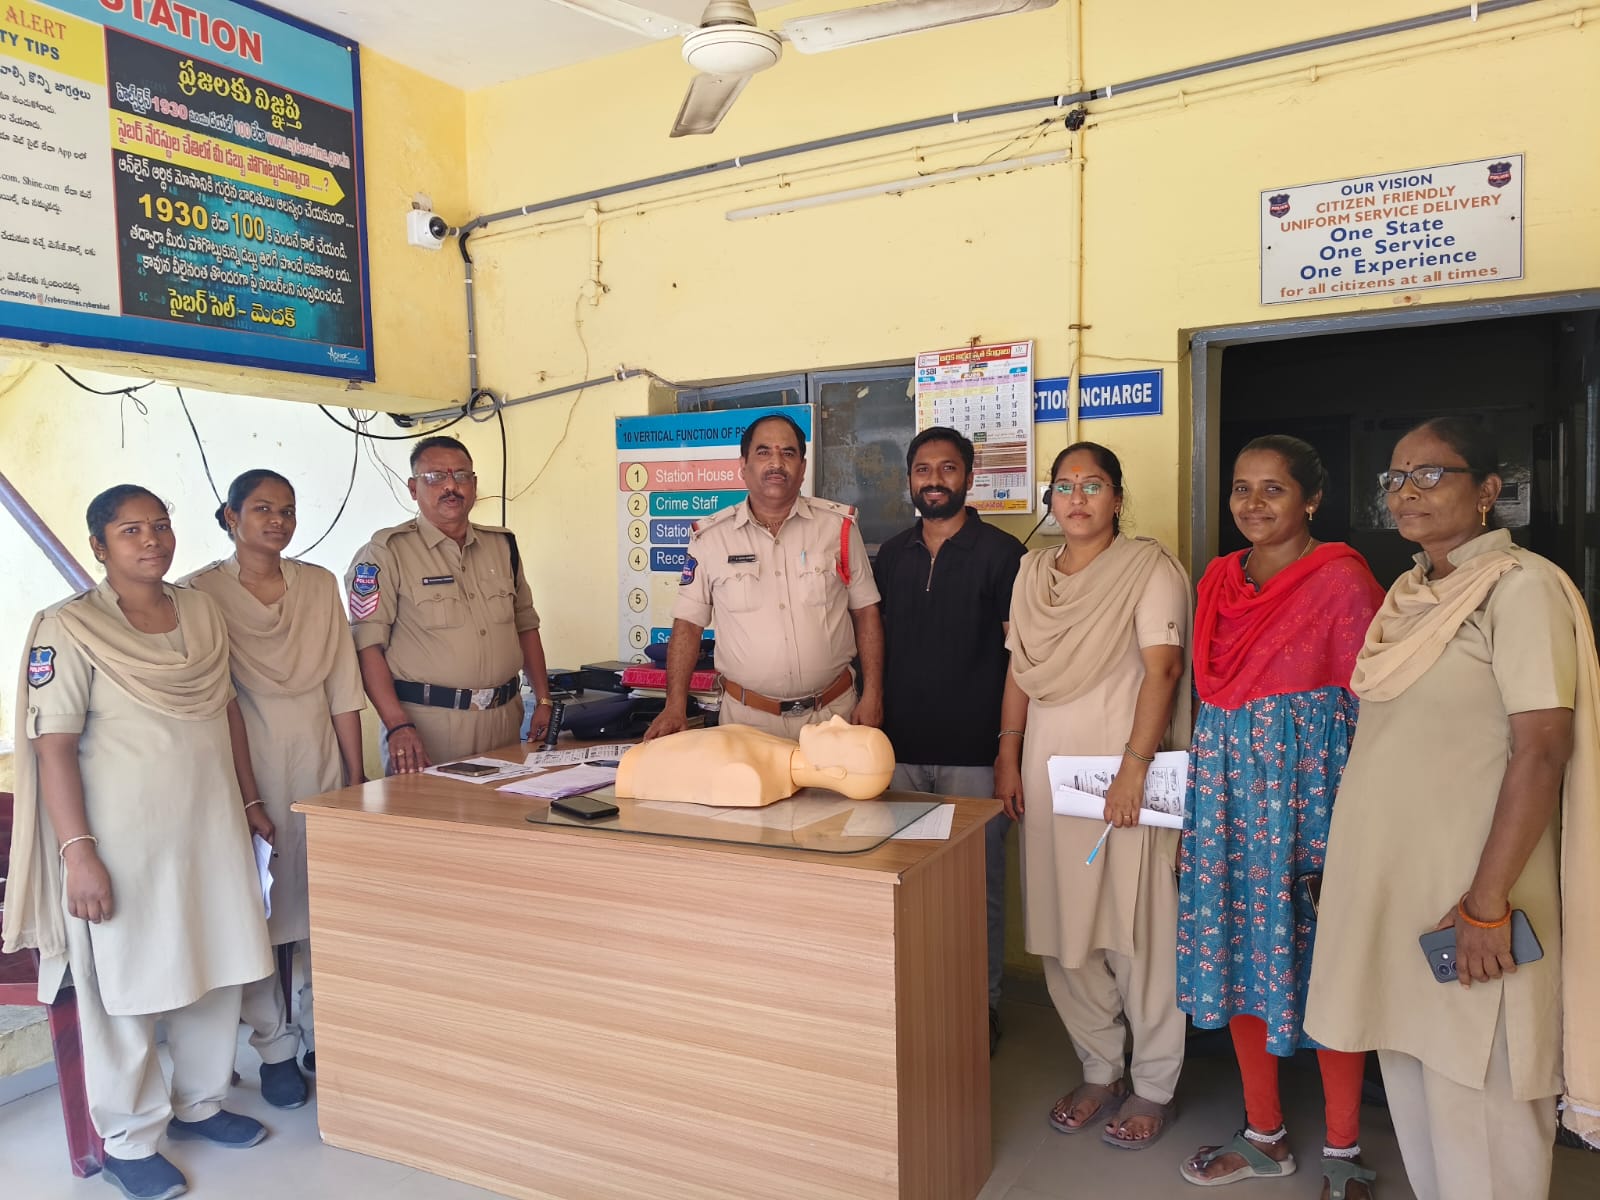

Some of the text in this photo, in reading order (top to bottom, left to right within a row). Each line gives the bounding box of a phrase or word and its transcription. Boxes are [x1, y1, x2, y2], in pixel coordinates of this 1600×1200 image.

[5, 6, 67, 40] ALERT
[0, 29, 60, 60] TY TIPS
[178, 60, 303, 132] ప్రజలకు విజ్ఞప్తి
[151, 96, 188, 120] 1930
[233, 119, 251, 140] 100
[58, 147, 72, 159] App
[117, 117, 144, 145] సైబర్
[213, 143, 224, 164] మీ
[225, 148, 246, 177] డబ్బు
[174, 168, 213, 192] మోసానికి
[214, 178, 238, 204] గురైన
[238, 188, 275, 209] బాధితులు
[1341, 173, 1433, 196] OUR VISION
[1280, 193, 1502, 233] UNIFORM SERVICE DELIVERY
[1316, 185, 1456, 214] CITIZEN FRIENDLY
[138, 193, 209, 231] 1930
[210, 212, 230, 231] లేదా
[231, 211, 266, 242] 100
[273, 228, 300, 249] వెంటనే
[300, 235, 316, 252] కాల్
[1330, 218, 1444, 243] One State
[129, 223, 165, 250] తద్వారా
[165, 227, 188, 249] మీరు
[241, 247, 259, 272] డబ్బు
[1319, 233, 1456, 261] One Service
[141, 254, 172, 275] కావున
[209, 264, 250, 286] తొందరగా
[250, 273, 259, 294] పై
[1300, 250, 1477, 280] One Experience
[1280, 266, 1498, 298] for all citizens at all times
[167, 287, 208, 318] సైబర్
[208, 293, 237, 319] సెల్
[250, 302, 297, 328] మెదక్
[926, 368, 937, 376] SBI
[1080, 382, 1153, 408] NCHARGE
[623, 432, 632, 443] 10
[633, 430, 674, 443] VERTICAL
[676, 428, 719, 441] FUNCTION
[721, 427, 733, 439] OF
[634, 470, 639, 483] 1
[655, 468, 694, 483] Station
[697, 468, 734, 482] House
[634, 495, 718, 511] 2 Crime Staff
[634, 527, 640, 538] 3
[634, 551, 685, 565] 4 Rece
[635, 593, 641, 605] 5
[635, 631, 641, 642] 6
